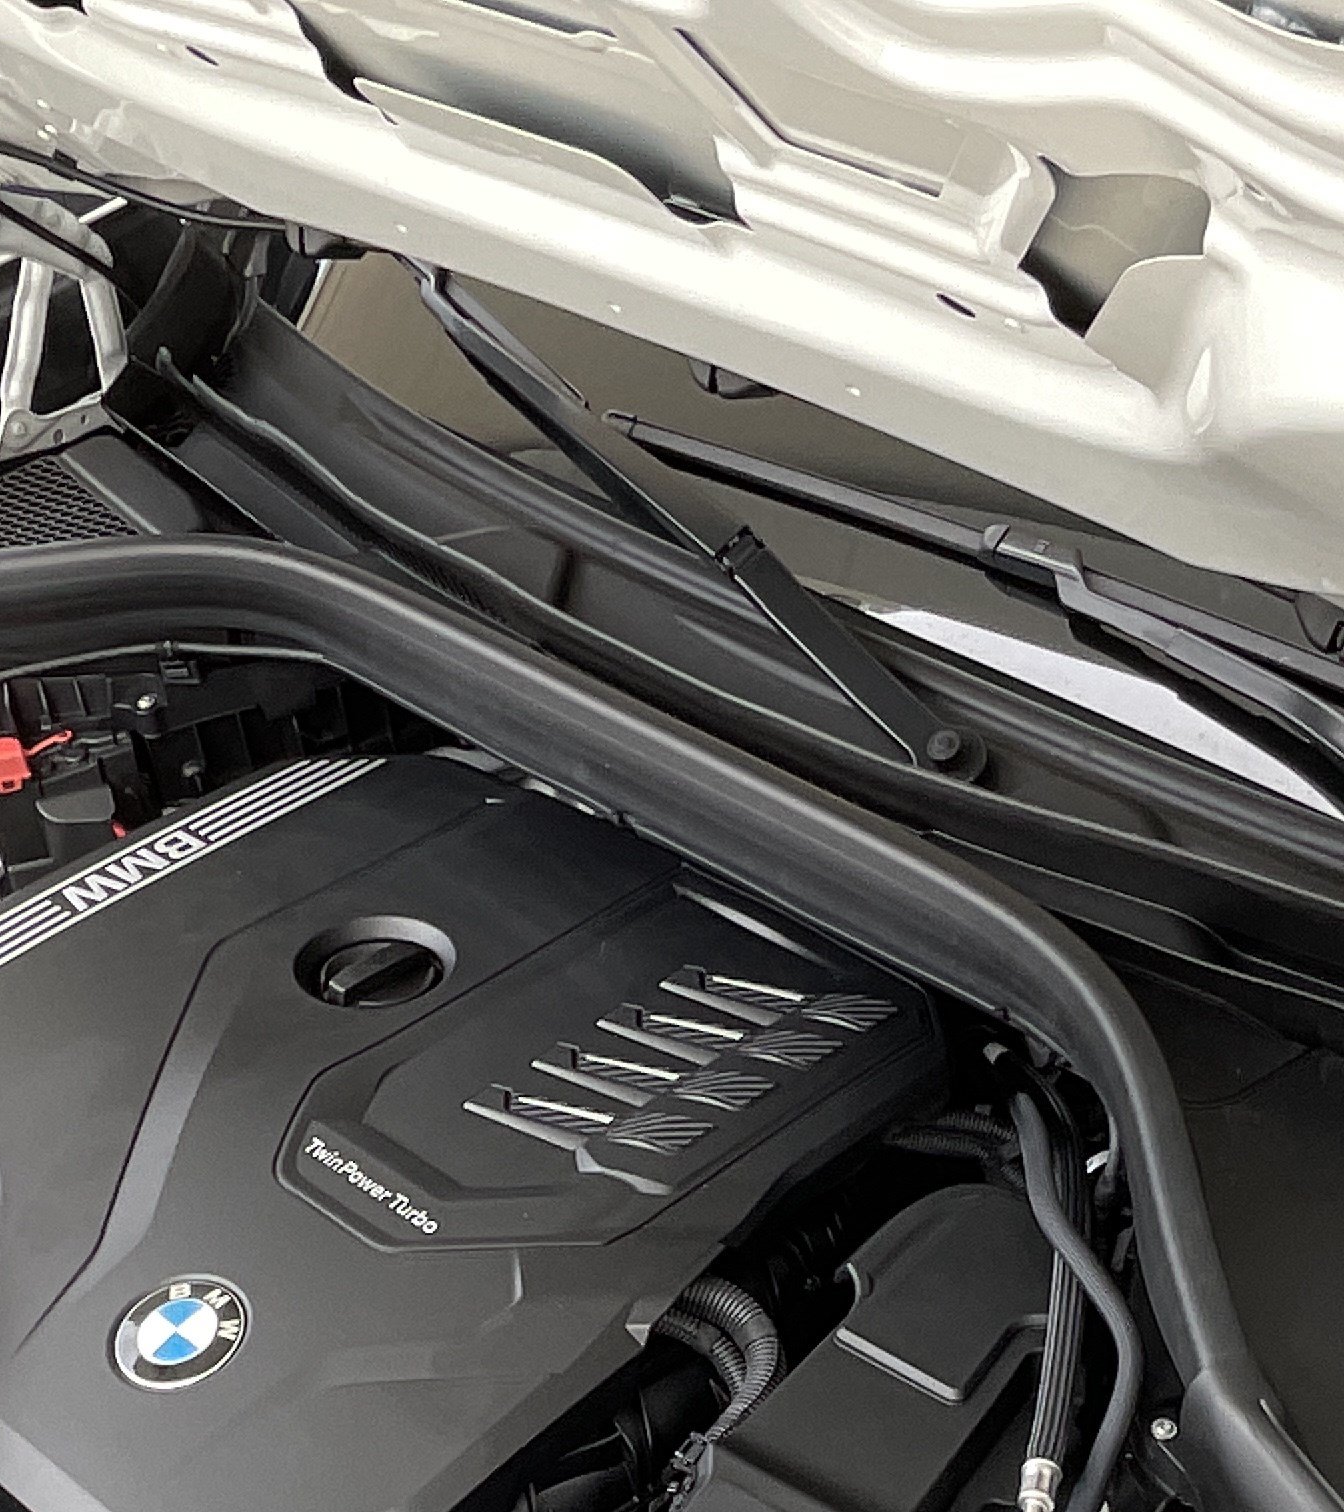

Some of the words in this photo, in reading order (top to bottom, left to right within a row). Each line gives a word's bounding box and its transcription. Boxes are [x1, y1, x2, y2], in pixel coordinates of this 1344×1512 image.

[62, 830, 207, 911] BMW
[305, 1137, 393, 1201] TwinPower
[388, 1193, 438, 1234] Turbo
[169, 1283, 241, 1341] BMW
